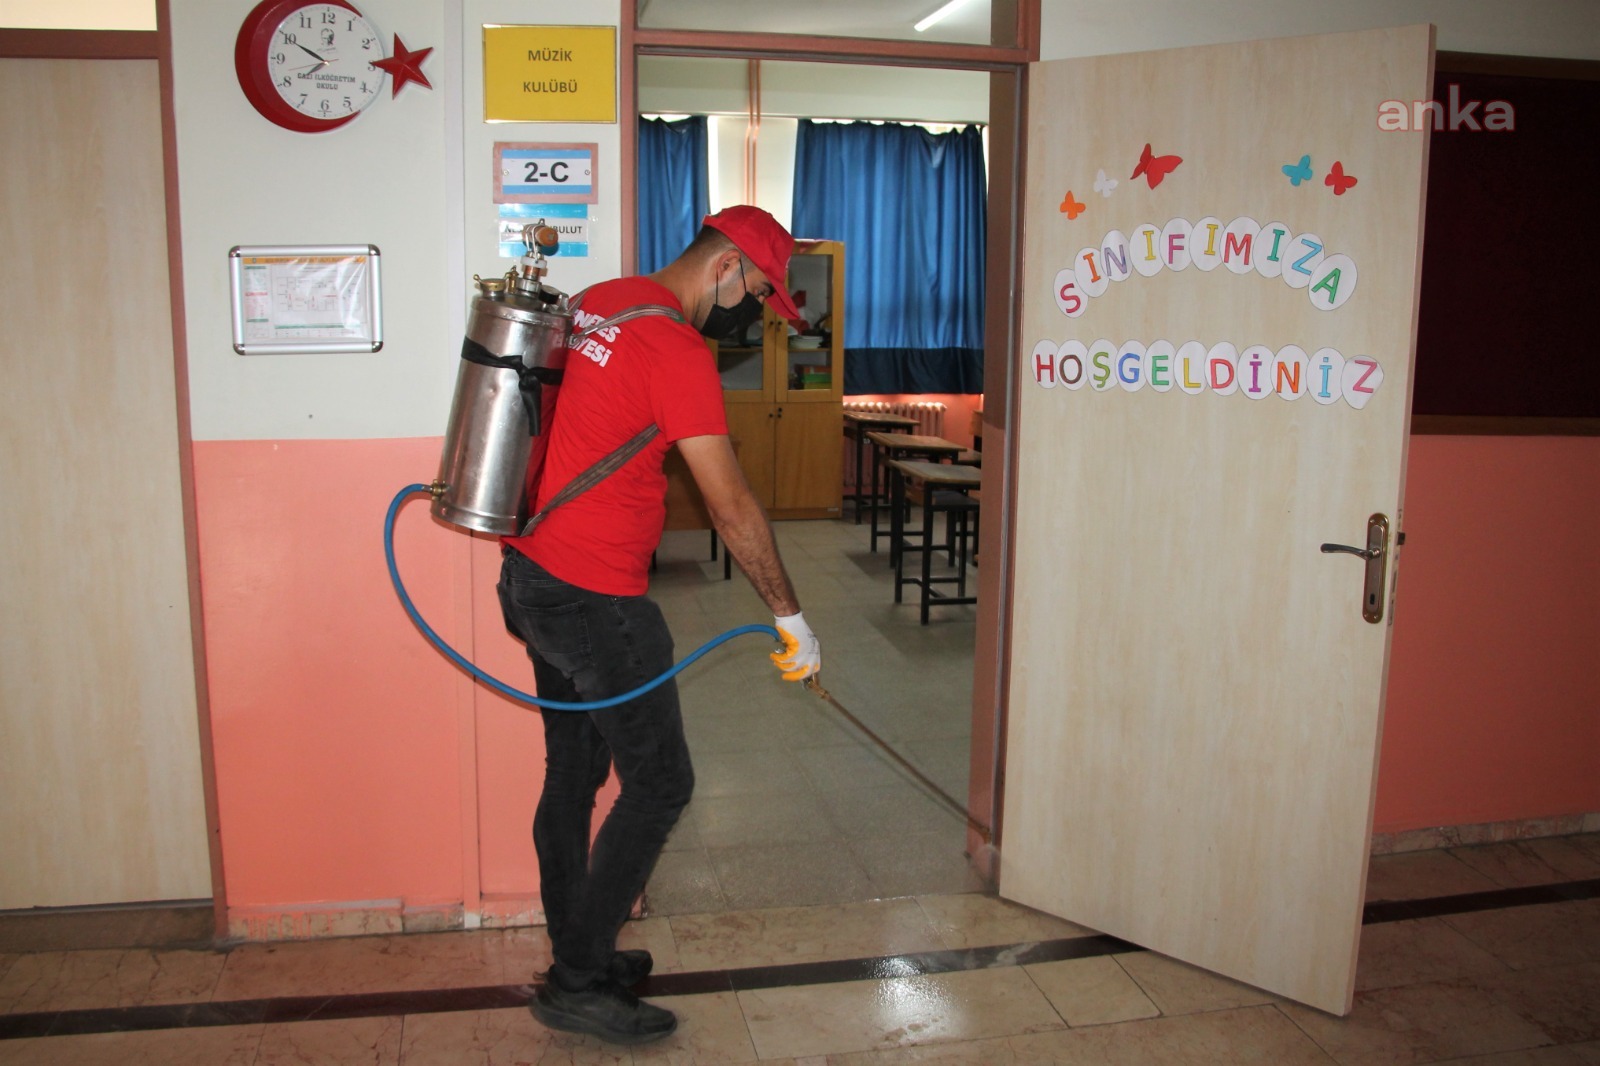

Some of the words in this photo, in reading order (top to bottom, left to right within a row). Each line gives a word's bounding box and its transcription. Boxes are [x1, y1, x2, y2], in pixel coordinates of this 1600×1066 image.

[300, 15, 312, 28] 11
[320, 12, 336, 24] 12
[347, 20, 354, 31] 1
[284, 33, 297, 45] 10
[362, 38, 371, 50] 2
[276, 53, 286, 64] 9
[528, 48, 572, 61] MÜZİK
[282, 75, 292, 88] 8
[360, 81, 368, 93] 4
[523, 79, 578, 93] KULÜBÜ
[300, 93, 308, 105] 7
[320, 99, 329, 111] 6
[343, 96, 351, 108] 5
[524, 161, 569, 183] 2-C
[1060, 223, 1342, 314] SINIFIMIZA
[1036, 351, 1378, 398] HOŞGELDİNİZ
